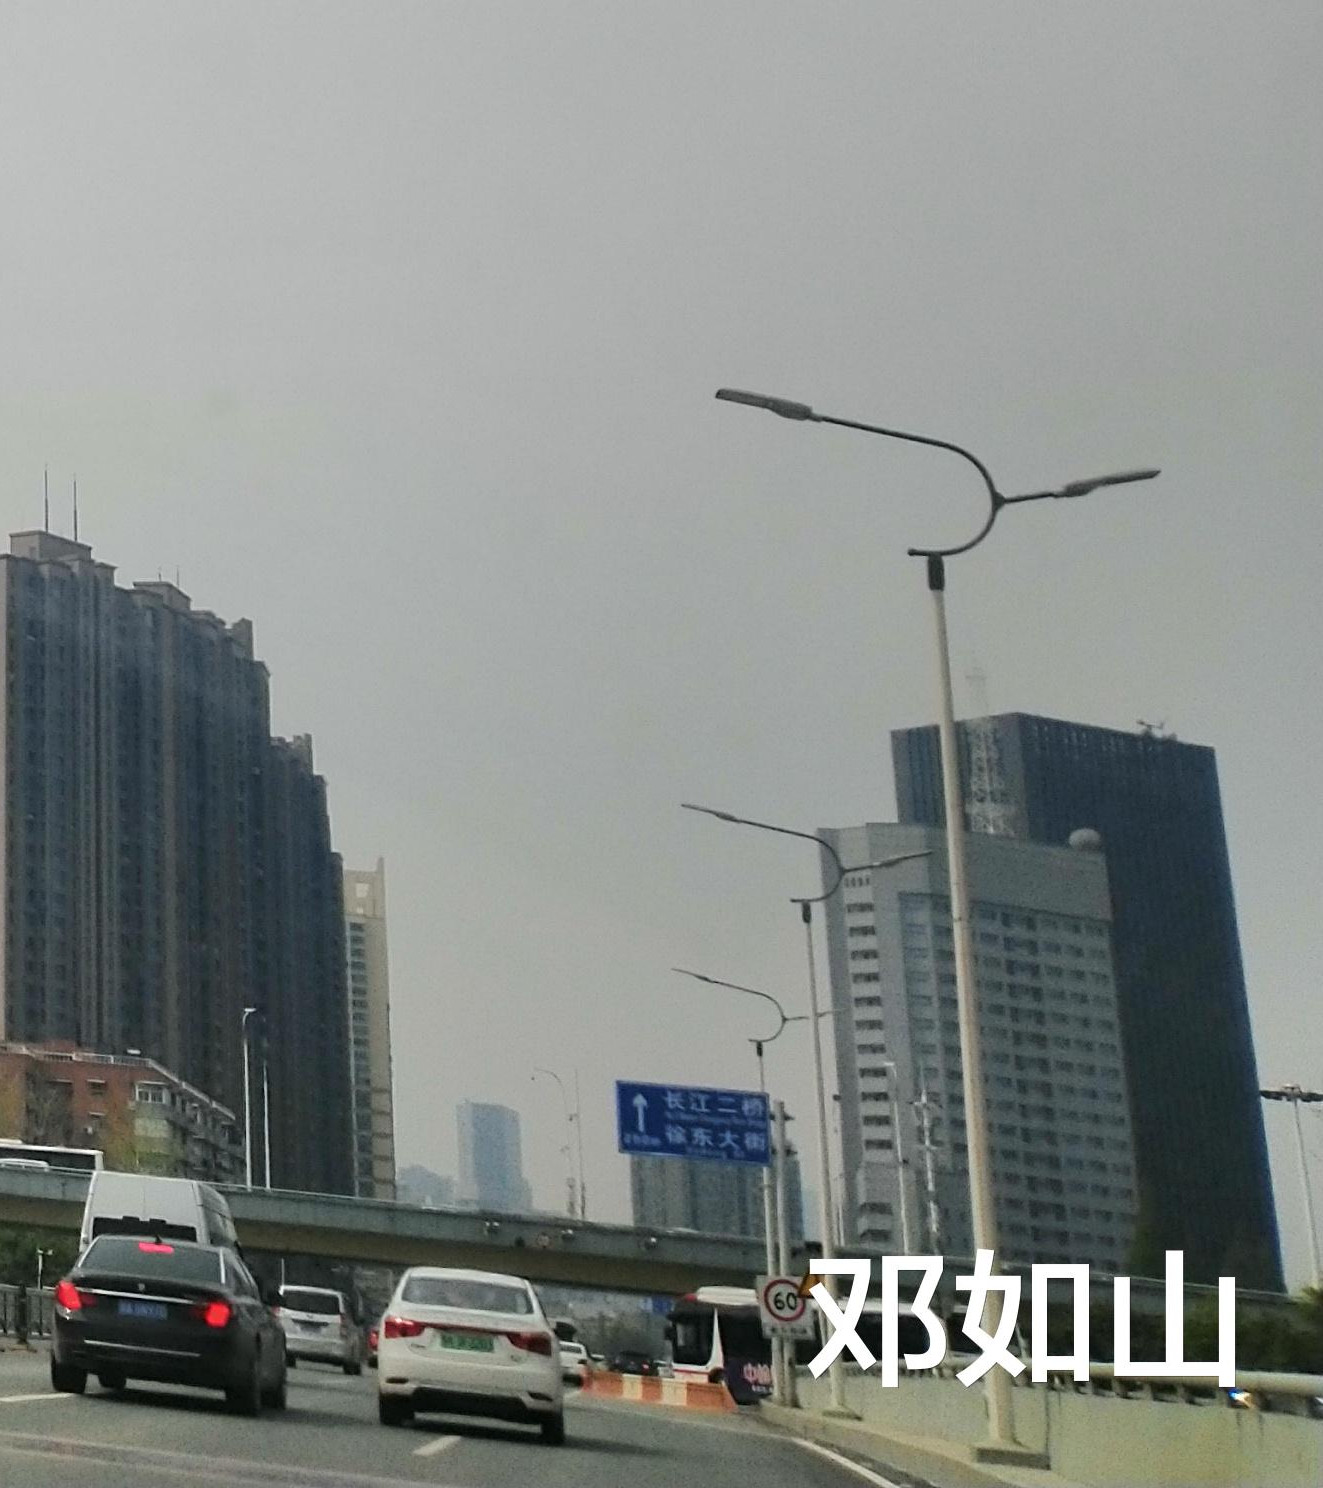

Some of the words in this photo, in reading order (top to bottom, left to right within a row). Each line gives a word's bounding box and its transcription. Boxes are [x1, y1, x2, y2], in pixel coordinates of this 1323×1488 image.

[664, 1090, 764, 1117] 长江二桥
[665, 1124, 765, 1151] 徐东大街
[774, 1292, 797, 1310] 60
